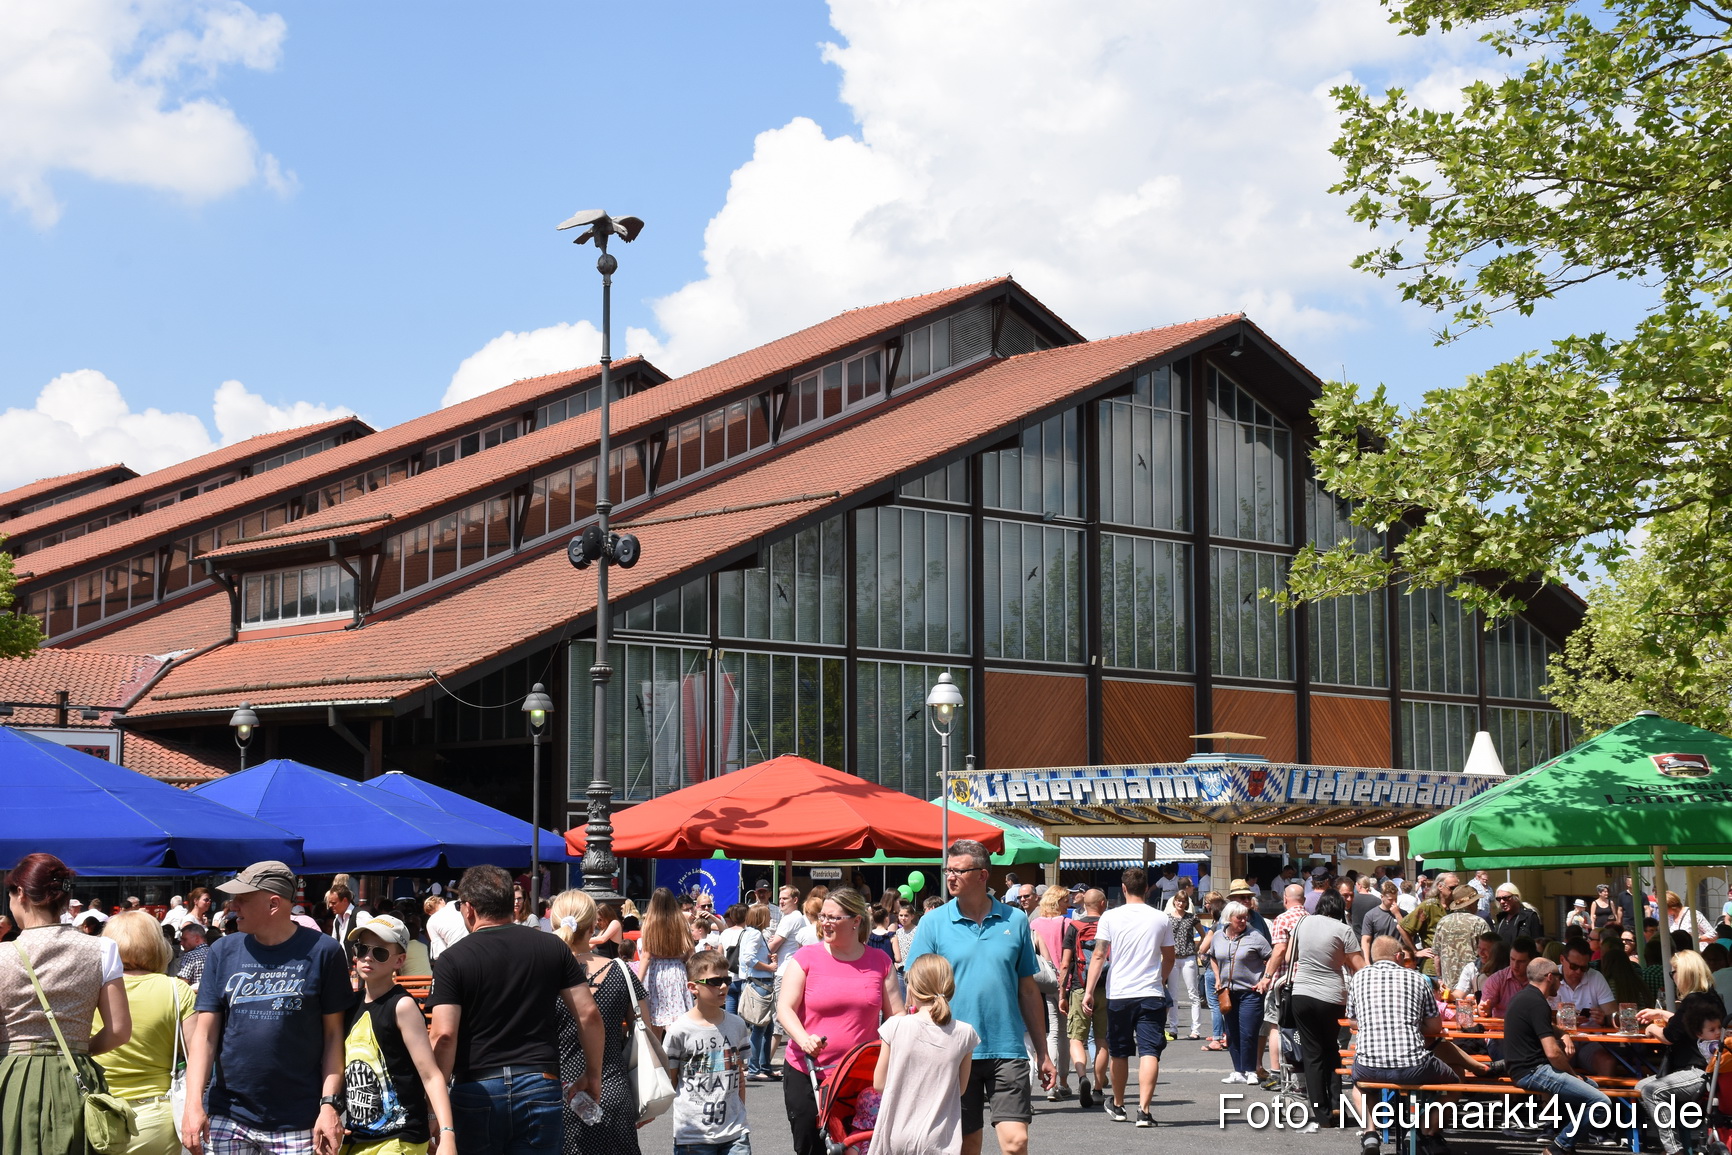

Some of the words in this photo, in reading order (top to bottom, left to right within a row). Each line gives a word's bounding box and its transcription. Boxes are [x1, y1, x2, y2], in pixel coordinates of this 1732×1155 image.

[978, 773, 1199, 803] Liebermann
[1288, 769, 1471, 806] Liebermann
[225, 972, 306, 1008] Terrain
[272, 998, 303, 1010] #62
[695, 1035, 731, 1051] U.S.A
[685, 1071, 740, 1093] SKATE
[357, 1092, 371, 1105] THE
[351, 1104, 378, 1119] MITS
[701, 1100, 727, 1126] 93
